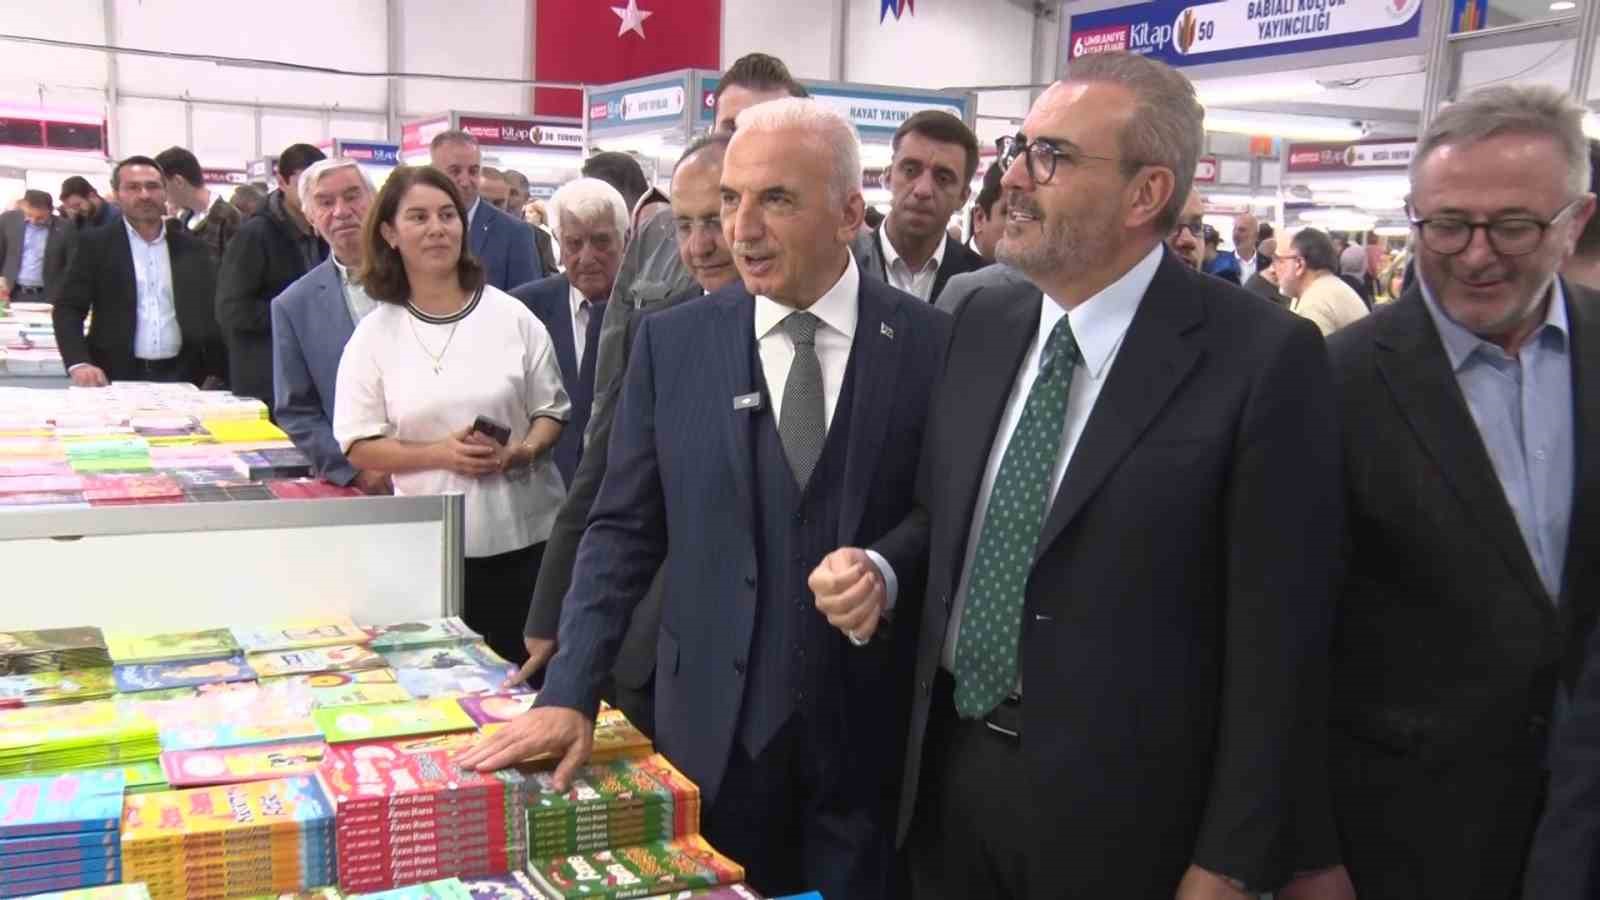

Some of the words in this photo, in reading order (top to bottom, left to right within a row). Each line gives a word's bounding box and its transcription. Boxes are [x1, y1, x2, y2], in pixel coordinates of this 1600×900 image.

[1198, 20, 1214, 41] 50
[1073, 37, 1084, 57] 6
[850, 106, 878, 121] HAYAT
